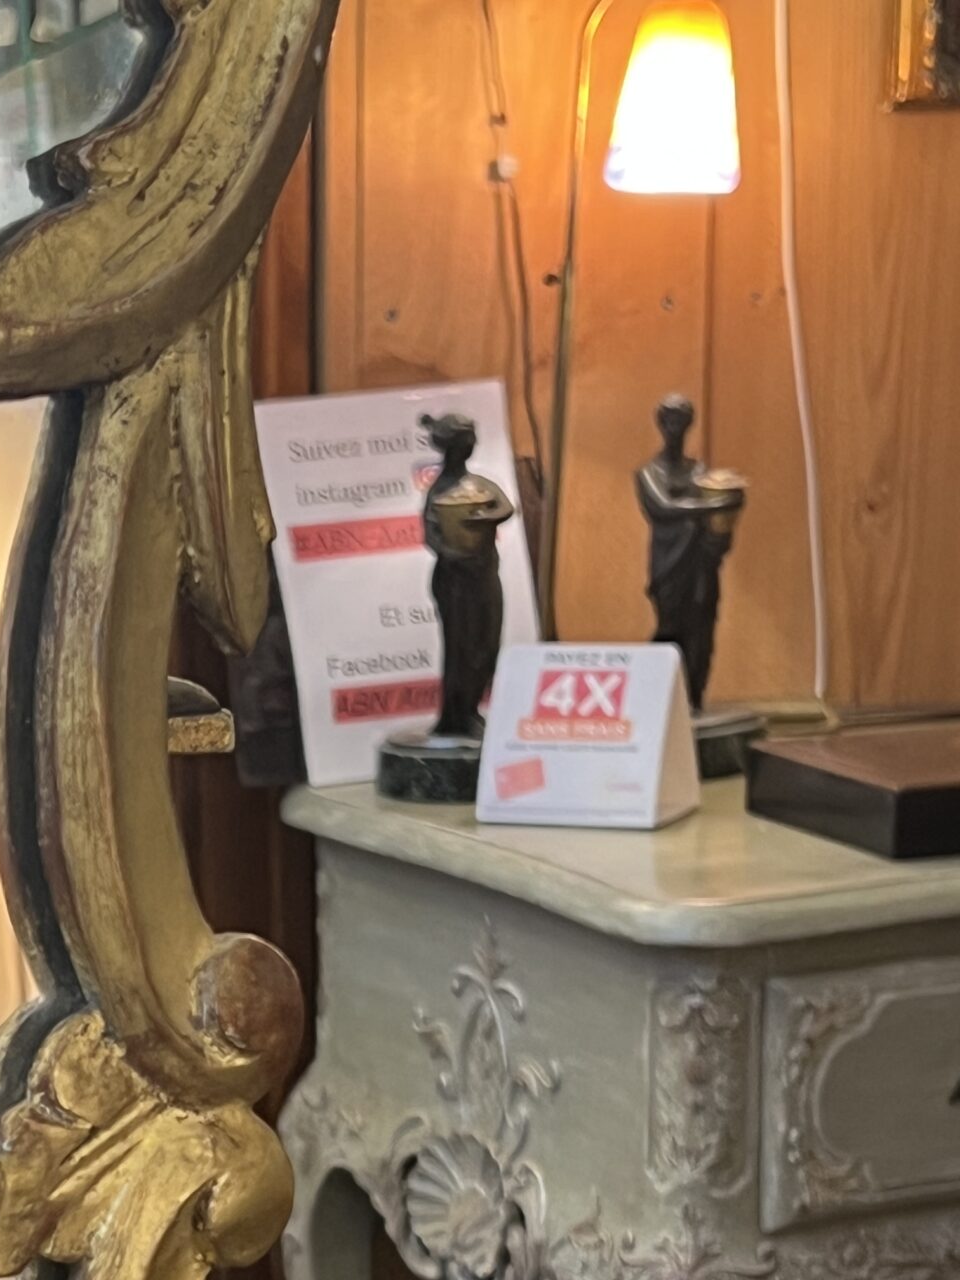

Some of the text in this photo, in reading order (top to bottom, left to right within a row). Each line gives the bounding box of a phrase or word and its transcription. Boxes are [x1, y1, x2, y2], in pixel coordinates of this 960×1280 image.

[288, 439, 361, 463] Suivez
[368, 432, 410, 454] moi
[295, 479, 407, 507] instagram
[293, 524, 422, 550] #ABN-Ant
[326, 650, 431, 677] Facebook
[539, 673, 622, 717] 4X
